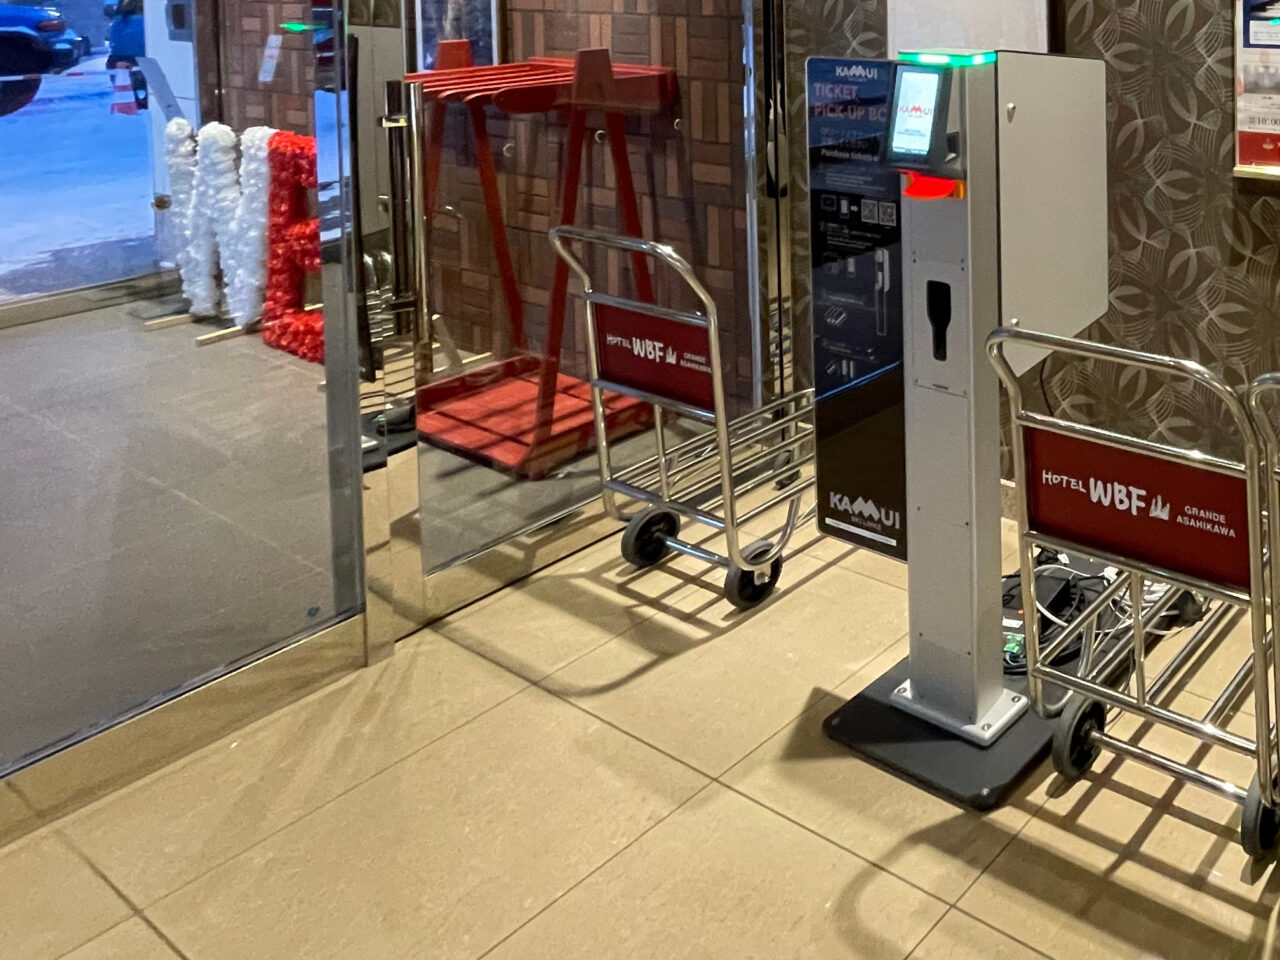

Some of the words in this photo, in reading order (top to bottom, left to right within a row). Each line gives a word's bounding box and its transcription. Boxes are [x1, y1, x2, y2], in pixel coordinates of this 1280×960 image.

[836, 65, 878, 79] KAMUI
[814, 83, 858, 99] TICKET
[814, 103, 865, 119] PICK-UP
[899, 105, 933, 116] KAMUI
[632, 336, 664, 363] WBF
[1042, 470, 1087, 493] HOTEL
[1089, 477, 1147, 516] WBF
[829, 491, 900, 529] KAMUI
[1184, 505, 1226, 523] GRANDE
[1176, 515, 1236, 538] ASAHIKAWA
